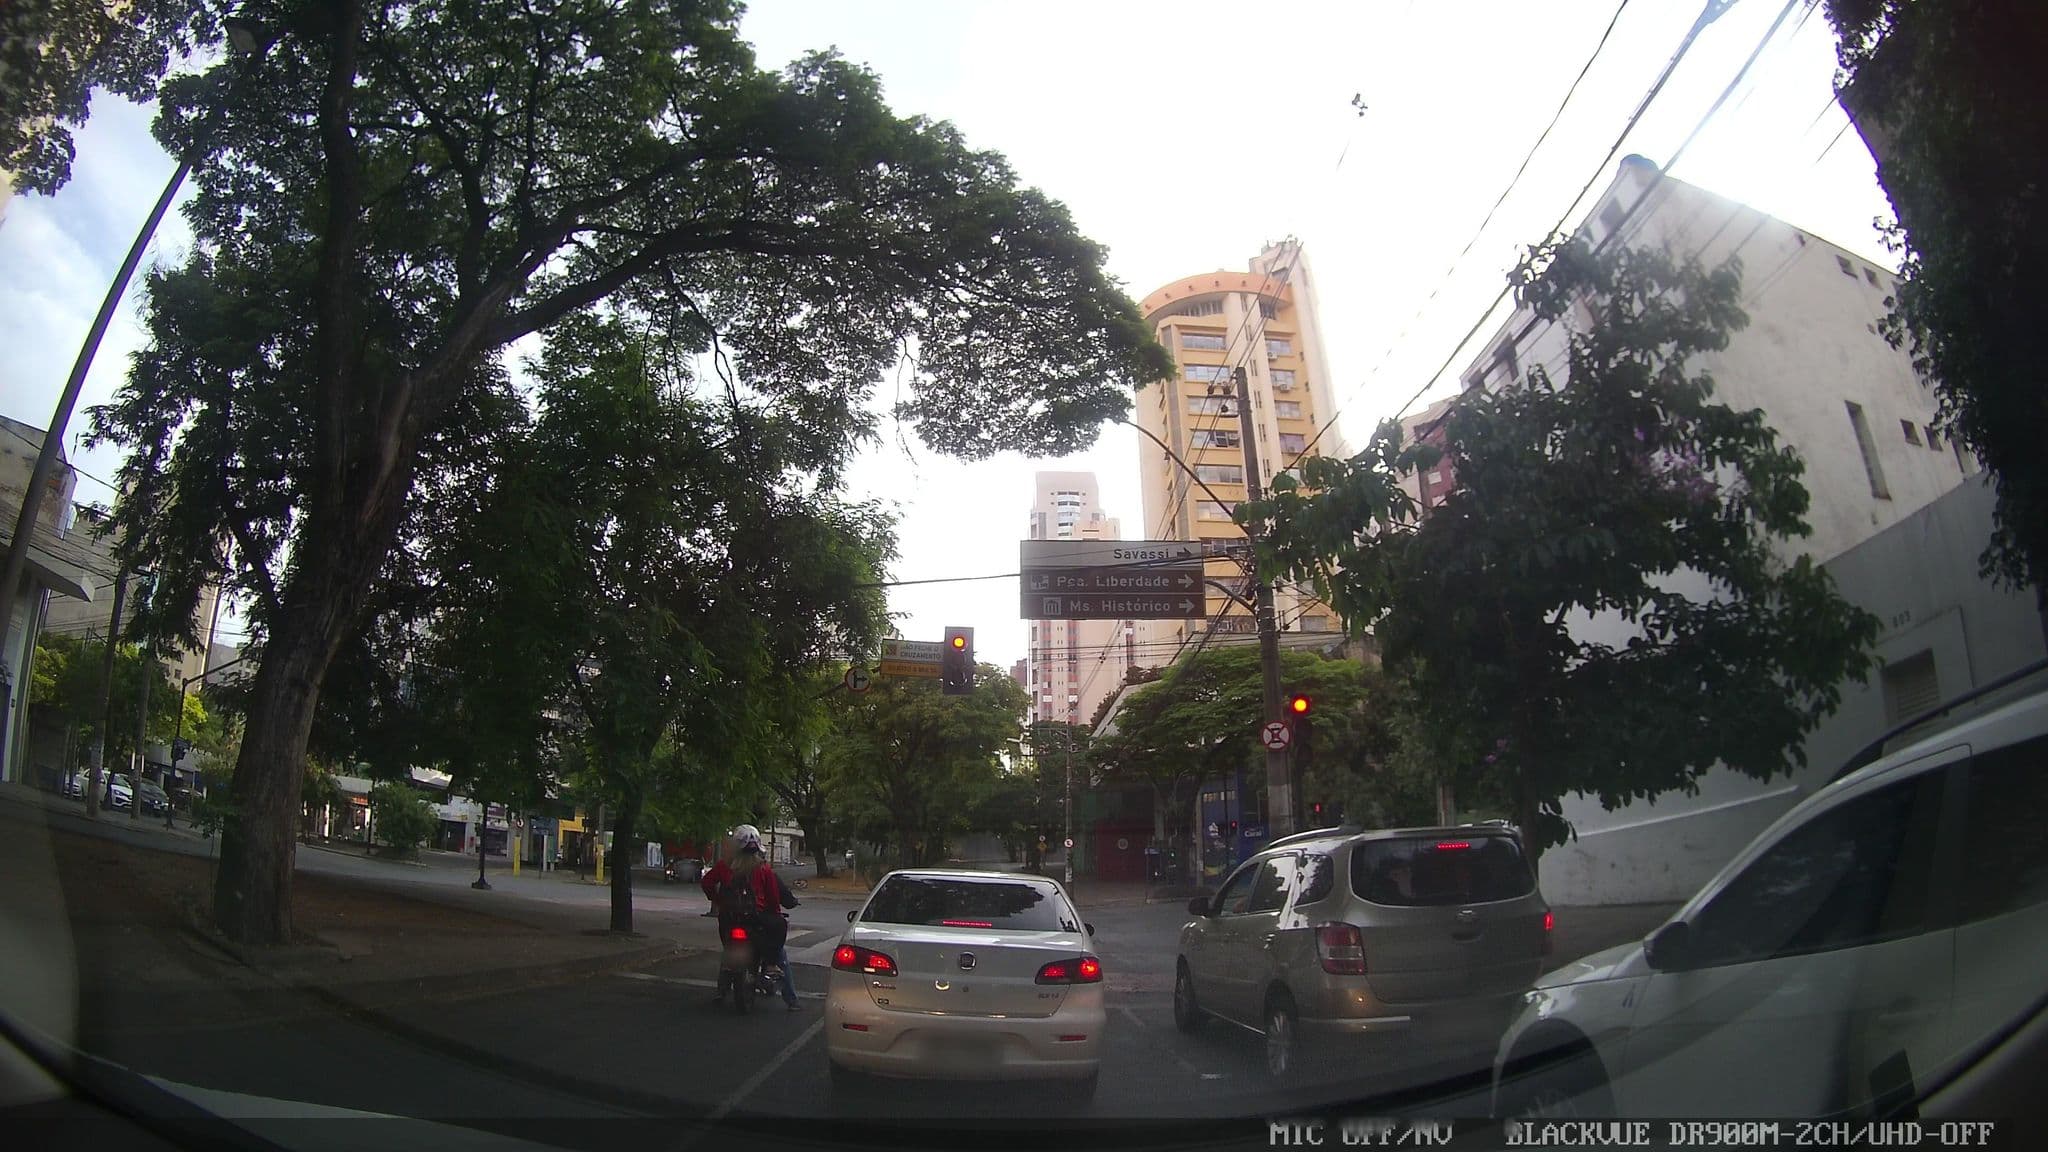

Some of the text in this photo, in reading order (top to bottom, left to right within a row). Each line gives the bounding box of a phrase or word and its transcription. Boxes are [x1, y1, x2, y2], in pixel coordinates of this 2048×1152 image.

[1113, 549, 1169, 560] Savassi
[1096, 575, 1170, 587] Liberdade
[1070, 598, 1170, 612] Ms. Histórico
